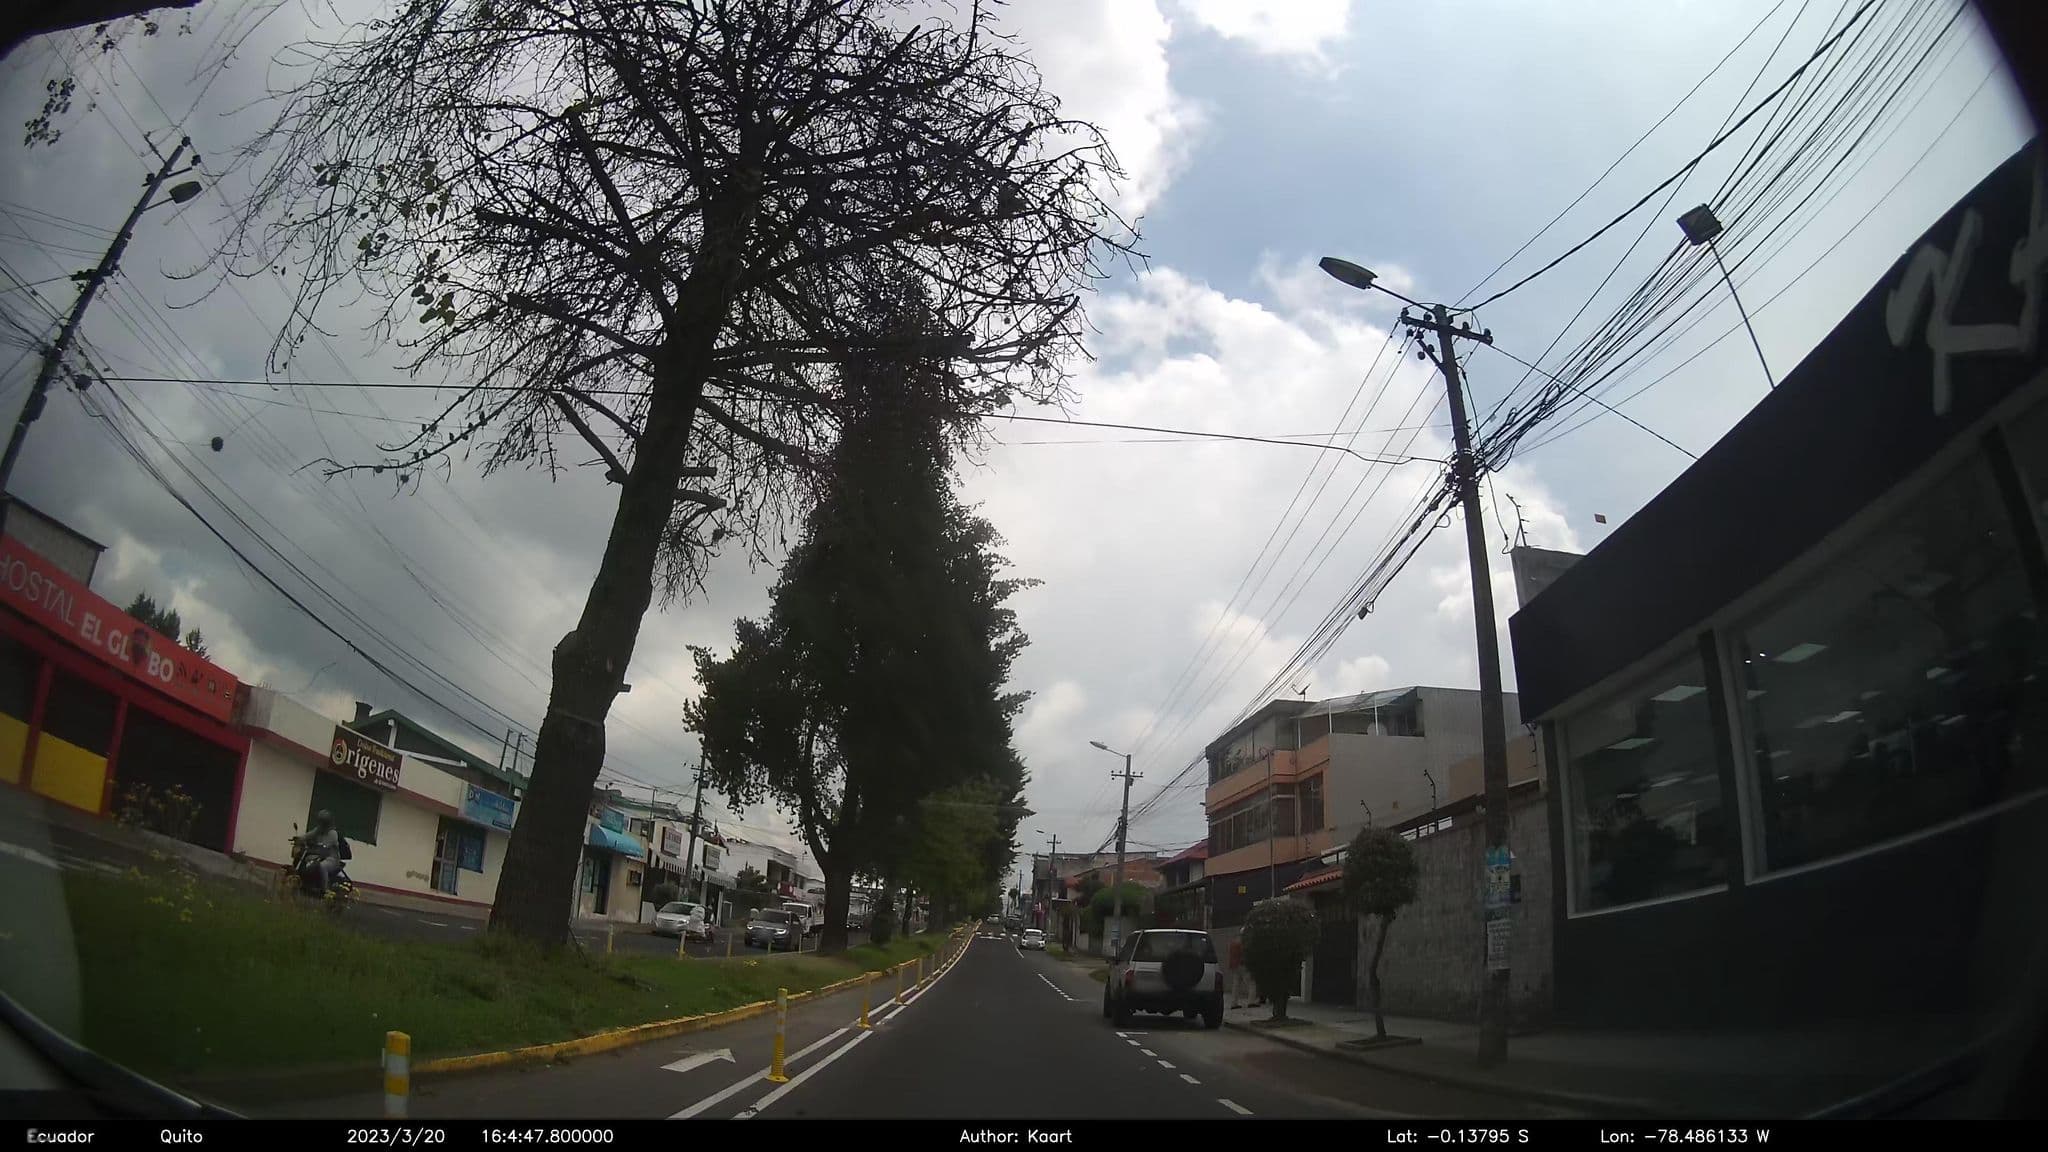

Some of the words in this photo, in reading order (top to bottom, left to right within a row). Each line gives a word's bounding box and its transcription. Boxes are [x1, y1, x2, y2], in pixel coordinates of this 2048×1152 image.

[0, 554, 74, 627] HOSTAL
[80, 611, 103, 646] EL
[331, 737, 400, 784] Orígenes
